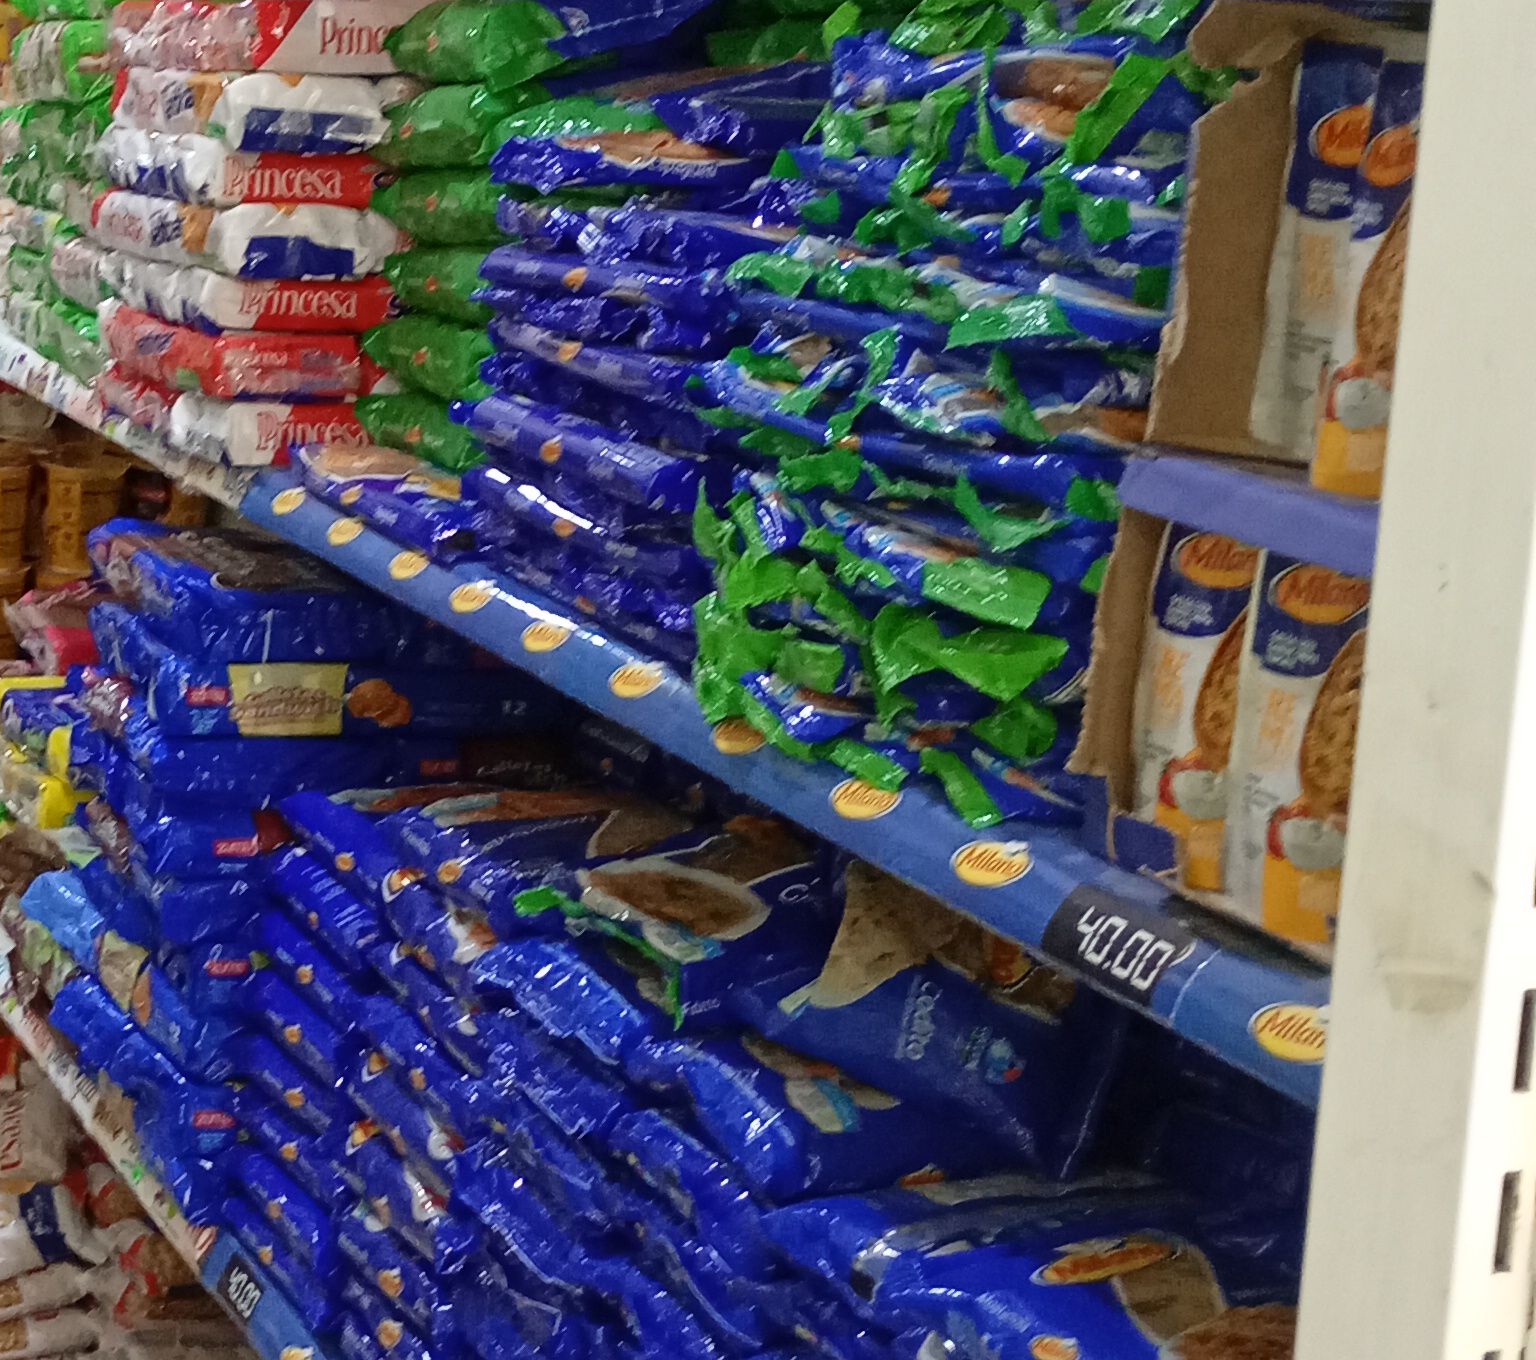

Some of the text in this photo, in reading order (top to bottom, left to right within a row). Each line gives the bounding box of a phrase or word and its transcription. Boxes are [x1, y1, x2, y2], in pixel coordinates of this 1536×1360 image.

[318, 15, 402, 57] Princ
[222, 153, 345, 203] Princesa
[240, 278, 359, 320] Princesa
[959, 851, 1026, 877] Milano
[1075, 904, 1176, 990] 40.00
